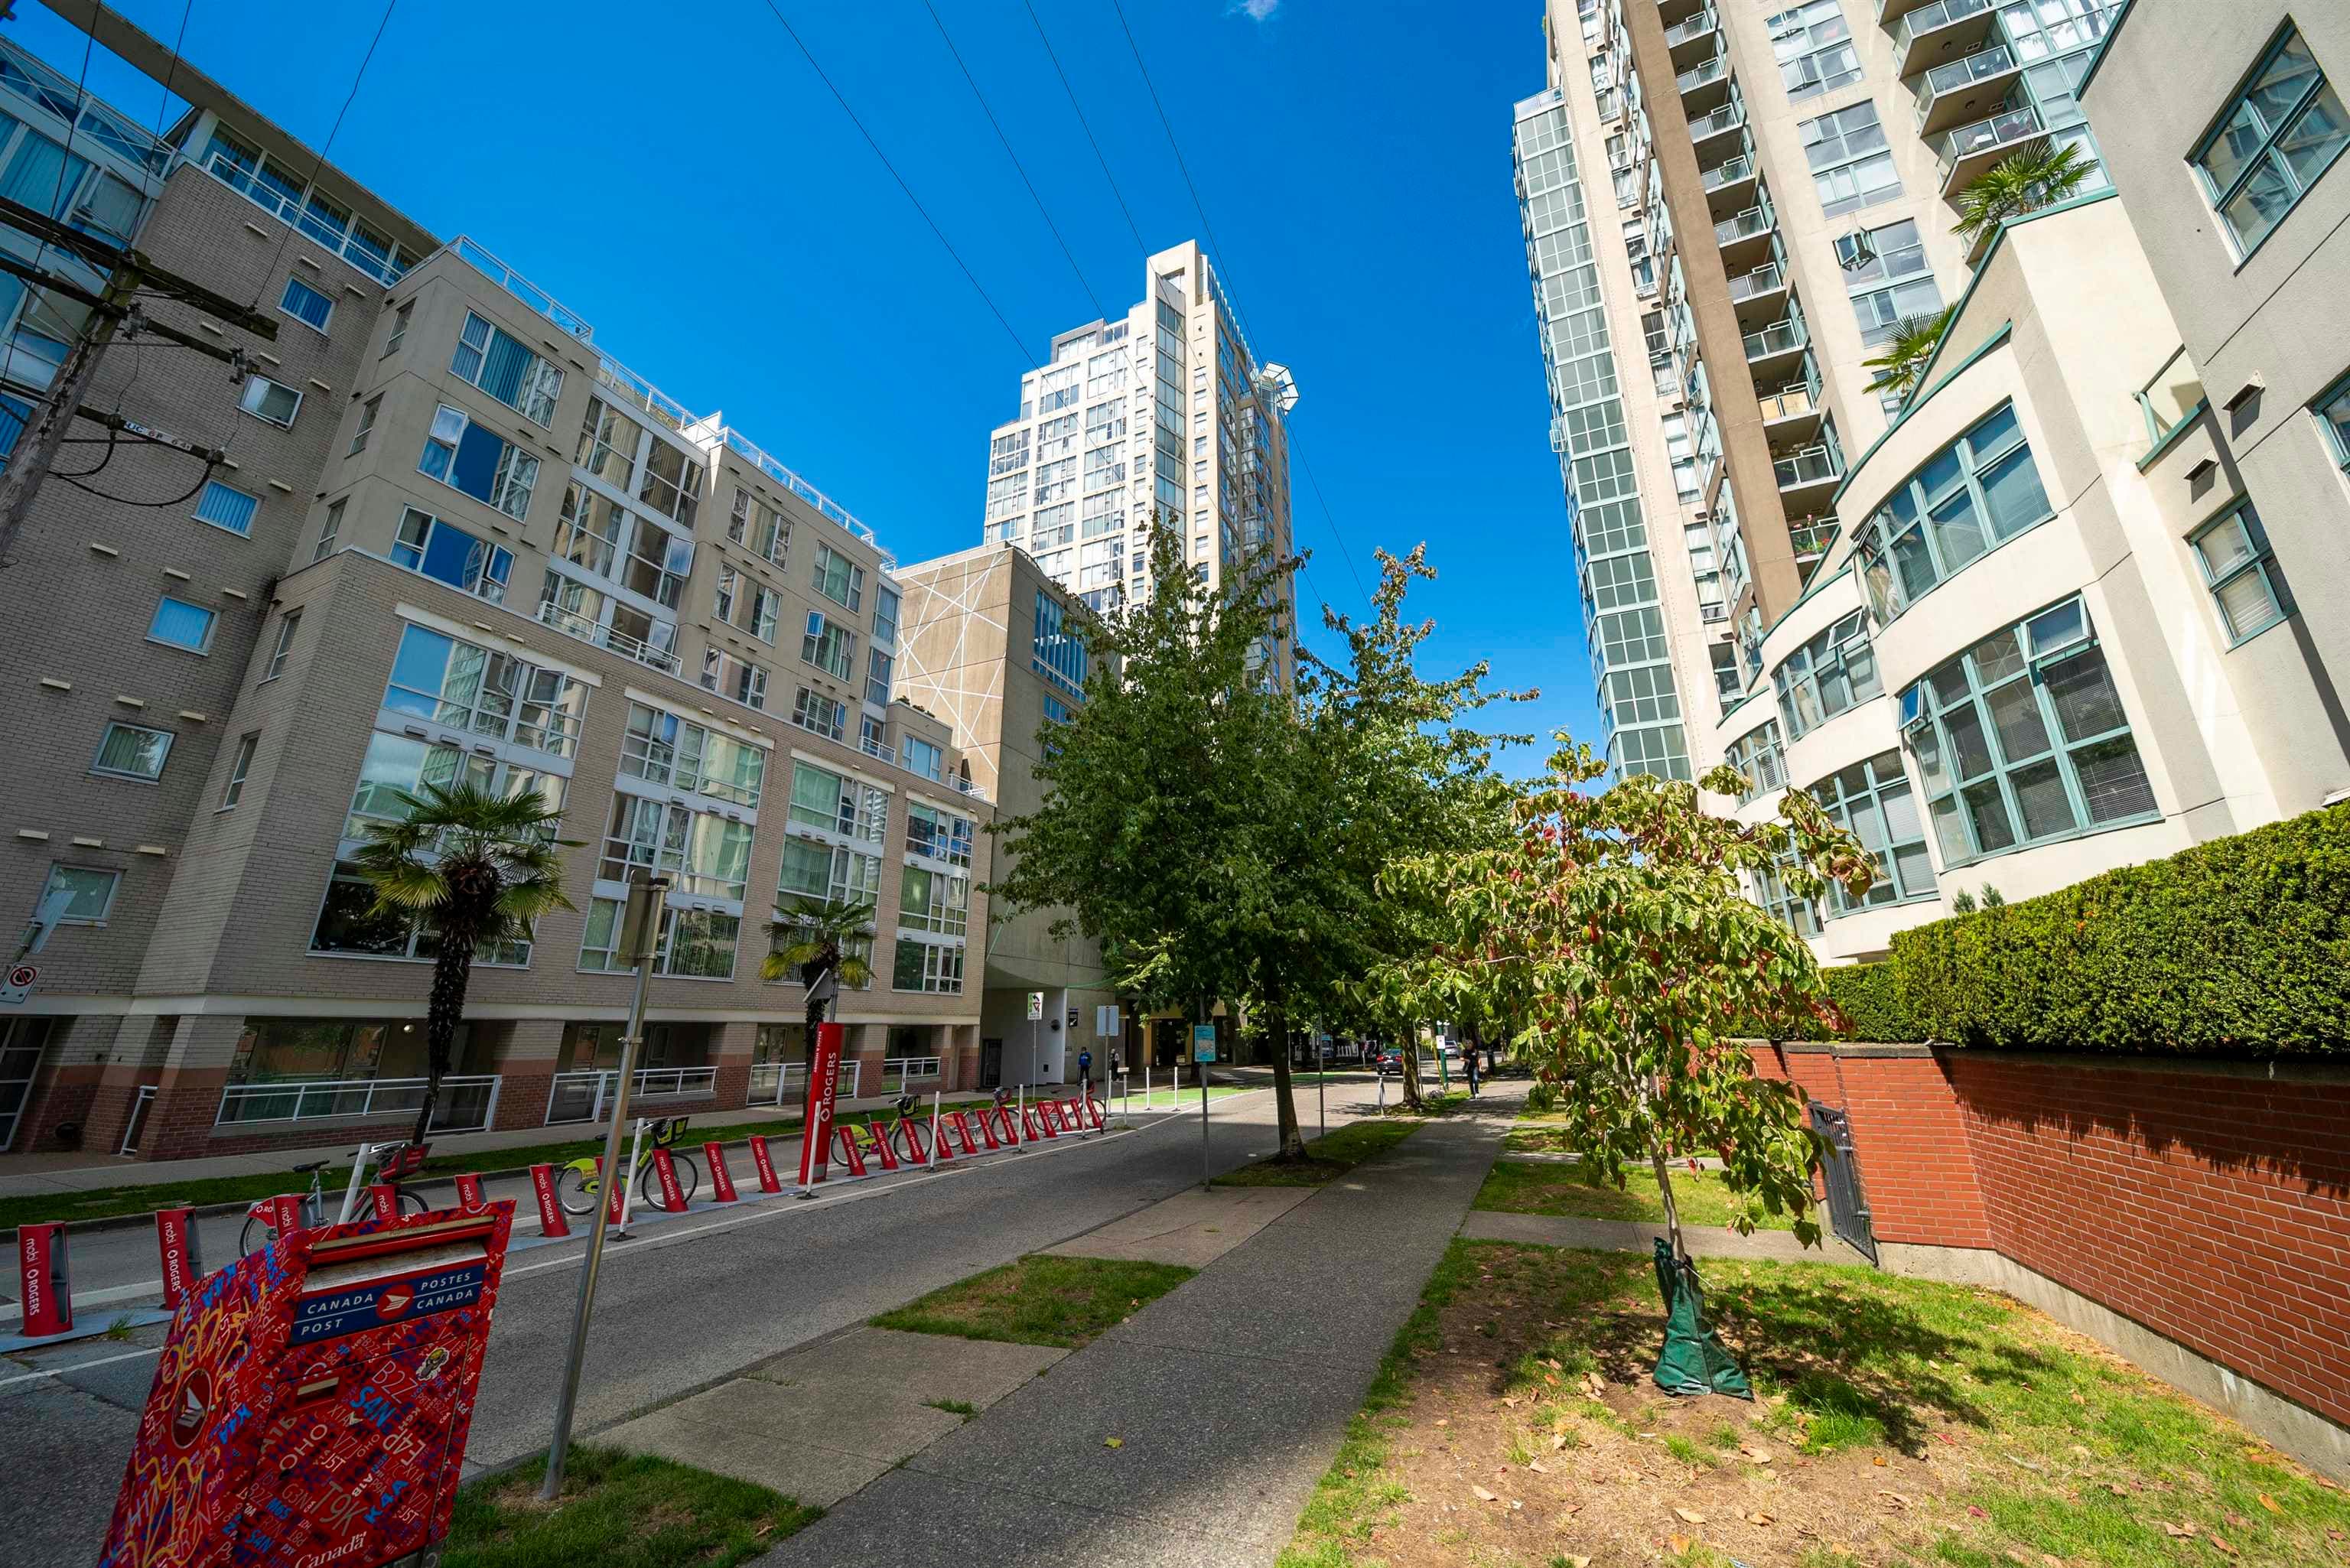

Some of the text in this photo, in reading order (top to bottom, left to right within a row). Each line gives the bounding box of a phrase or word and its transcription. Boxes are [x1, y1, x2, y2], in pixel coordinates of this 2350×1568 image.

[822, 1052, 837, 1106] ROGERS
[464, 1183, 474, 1202] mobi
[659, 1156, 676, 1202] mobi ROGERS
[378, 1194, 390, 1215] mobi
[538, 1173, 555, 1225] mobi ROGERS
[281, 1206, 294, 1228] mobi
[164, 1222, 182, 1292] mobi ROGERS
[24, 1238, 41, 1316] mobi ROGERS
[421, 1272, 471, 1291] POSTES
[307, 1293, 374, 1315] CANADA
[416, 1289, 474, 1310] CANADA
[300, 1317, 343, 1336] POST
[371, 1359, 418, 1404] B2Z
[350, 1385, 397, 1428] S4N
[321, 1452, 347, 1472] J5T
[309, 1480, 368, 1537] T9K
[398, 1507, 420, 1524] J5T
[295, 1531, 368, 1568] Canada
